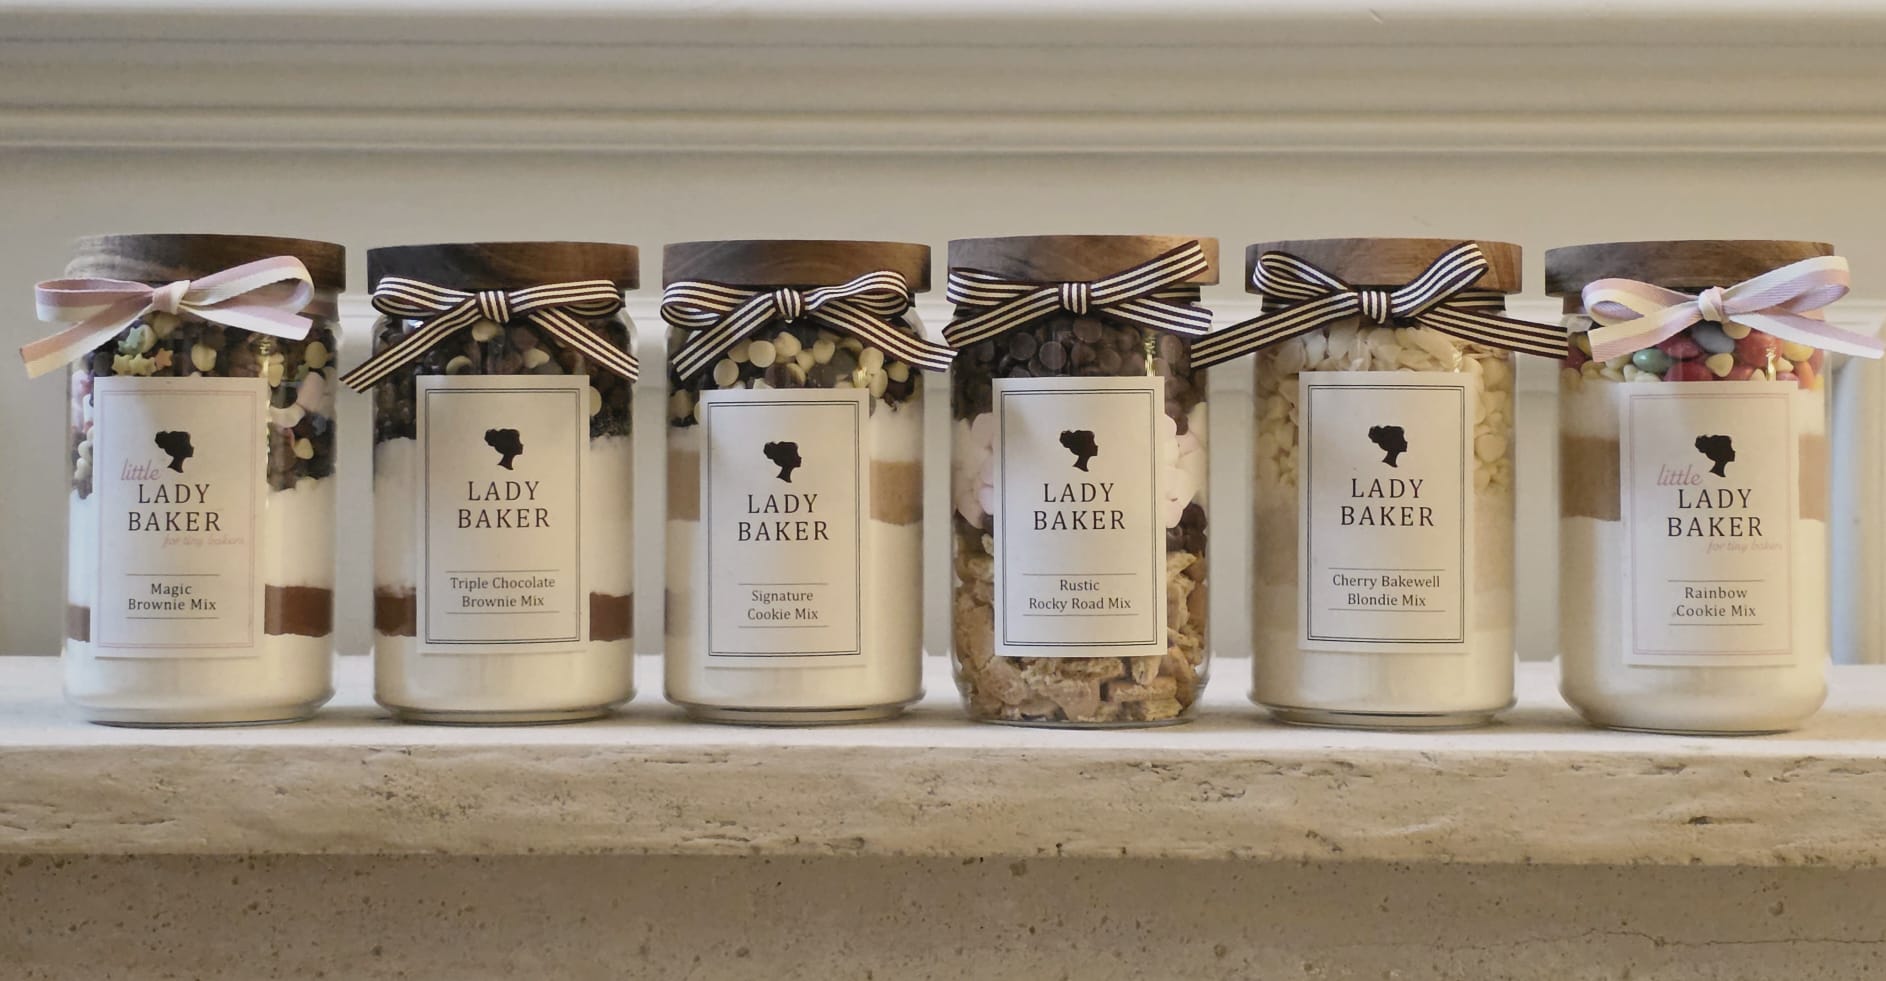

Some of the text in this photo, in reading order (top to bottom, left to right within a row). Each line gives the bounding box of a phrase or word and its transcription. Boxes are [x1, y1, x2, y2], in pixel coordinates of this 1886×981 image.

[121, 458, 160, 481] little
[1656, 464, 1702, 486] little
[138, 483, 210, 504] LADY
[467, 480, 541, 502] LADY
[1043, 482, 1115, 504] LADY
[1351, 478, 1424, 499] LADY
[1678, 488, 1752, 509] LADY
[747, 493, 819, 514] LADY
[128, 511, 221, 532] BAKER
[458, 508, 551, 529] BAKER
[1033, 510, 1126, 531] BAKER
[1341, 505, 1434, 527] BAKER
[1667, 516, 1763, 537] BAKER
[737, 520, 830, 542] BAKER
[150, 583, 192, 598] Magic
[450, 575, 556, 591] Triple Chocolate
[1059, 579, 1101, 592] Rustic
[1332, 573, 1441, 591] Cherry Bakewell
[1684, 585, 1748, 600] Rainbow
[128, 597, 217, 611] Brownie Mix
[462, 595, 544, 608] Brownie Mix
[751, 589, 814, 606] Signature
[1029, 597, 1132, 613] Rocky Road Mix
[1347, 593, 1427, 607] Blondie Mix
[747, 607, 819, 621] Cookie Mix
[1676, 603, 1757, 618] Cookie Mix
